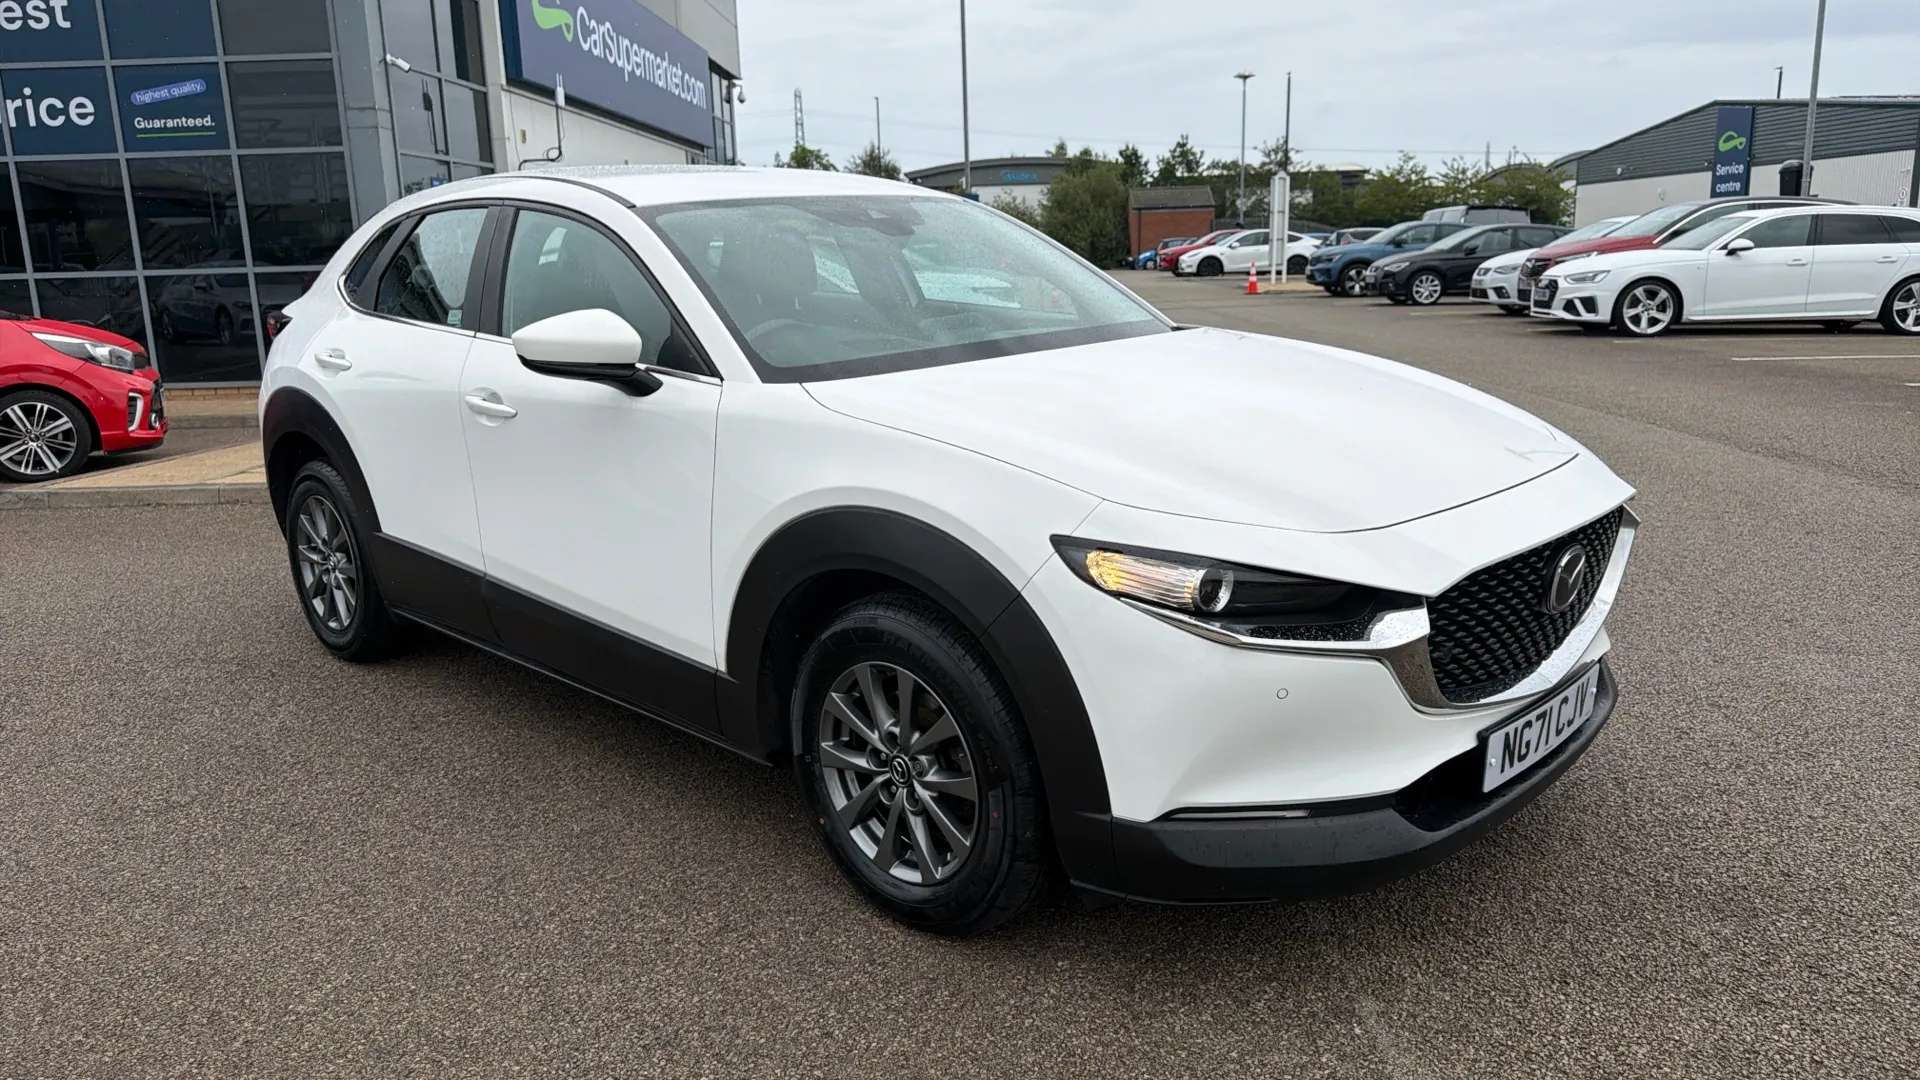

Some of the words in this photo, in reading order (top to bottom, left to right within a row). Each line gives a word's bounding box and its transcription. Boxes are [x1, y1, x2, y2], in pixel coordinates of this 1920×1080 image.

[576, 6, 707, 110] CarSupermarket.com
[135, 89, 170, 103] highest
[134, 114, 215, 129] Guaranteed.
[1716, 161, 1744, 176] Service
[1715, 181, 1741, 193] centre
[1500, 705, 1553, 774] NG71
[1555, 676, 1590, 737] CJV
